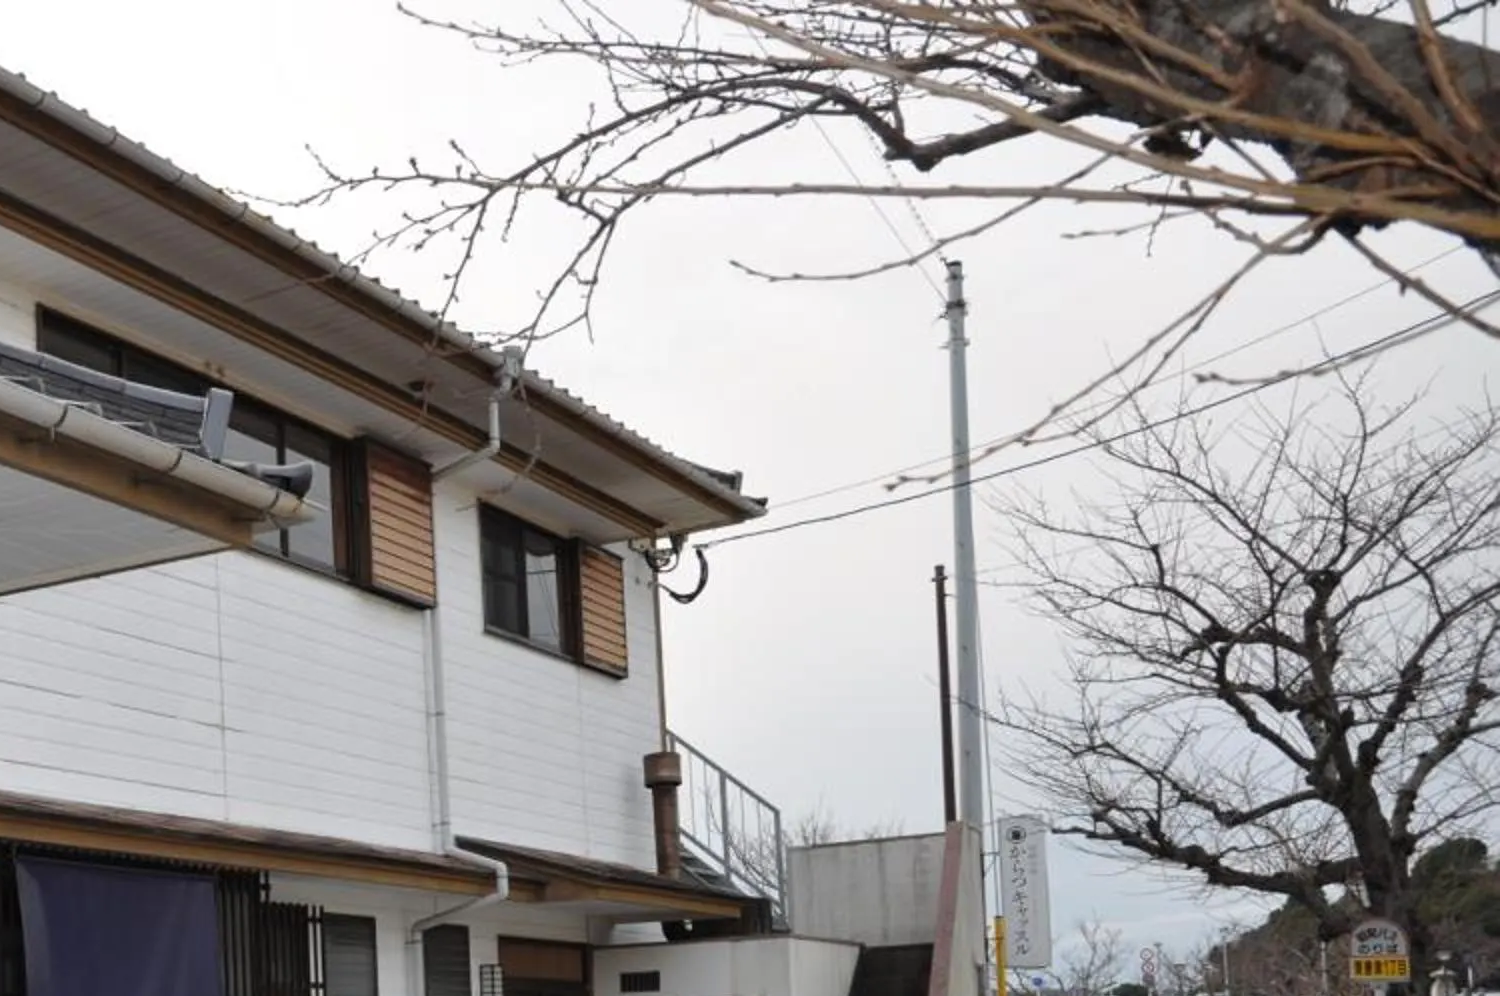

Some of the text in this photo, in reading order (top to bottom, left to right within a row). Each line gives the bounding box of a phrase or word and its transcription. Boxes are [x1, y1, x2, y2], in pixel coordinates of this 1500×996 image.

[1008, 847, 1030, 956] からつキャッスル
